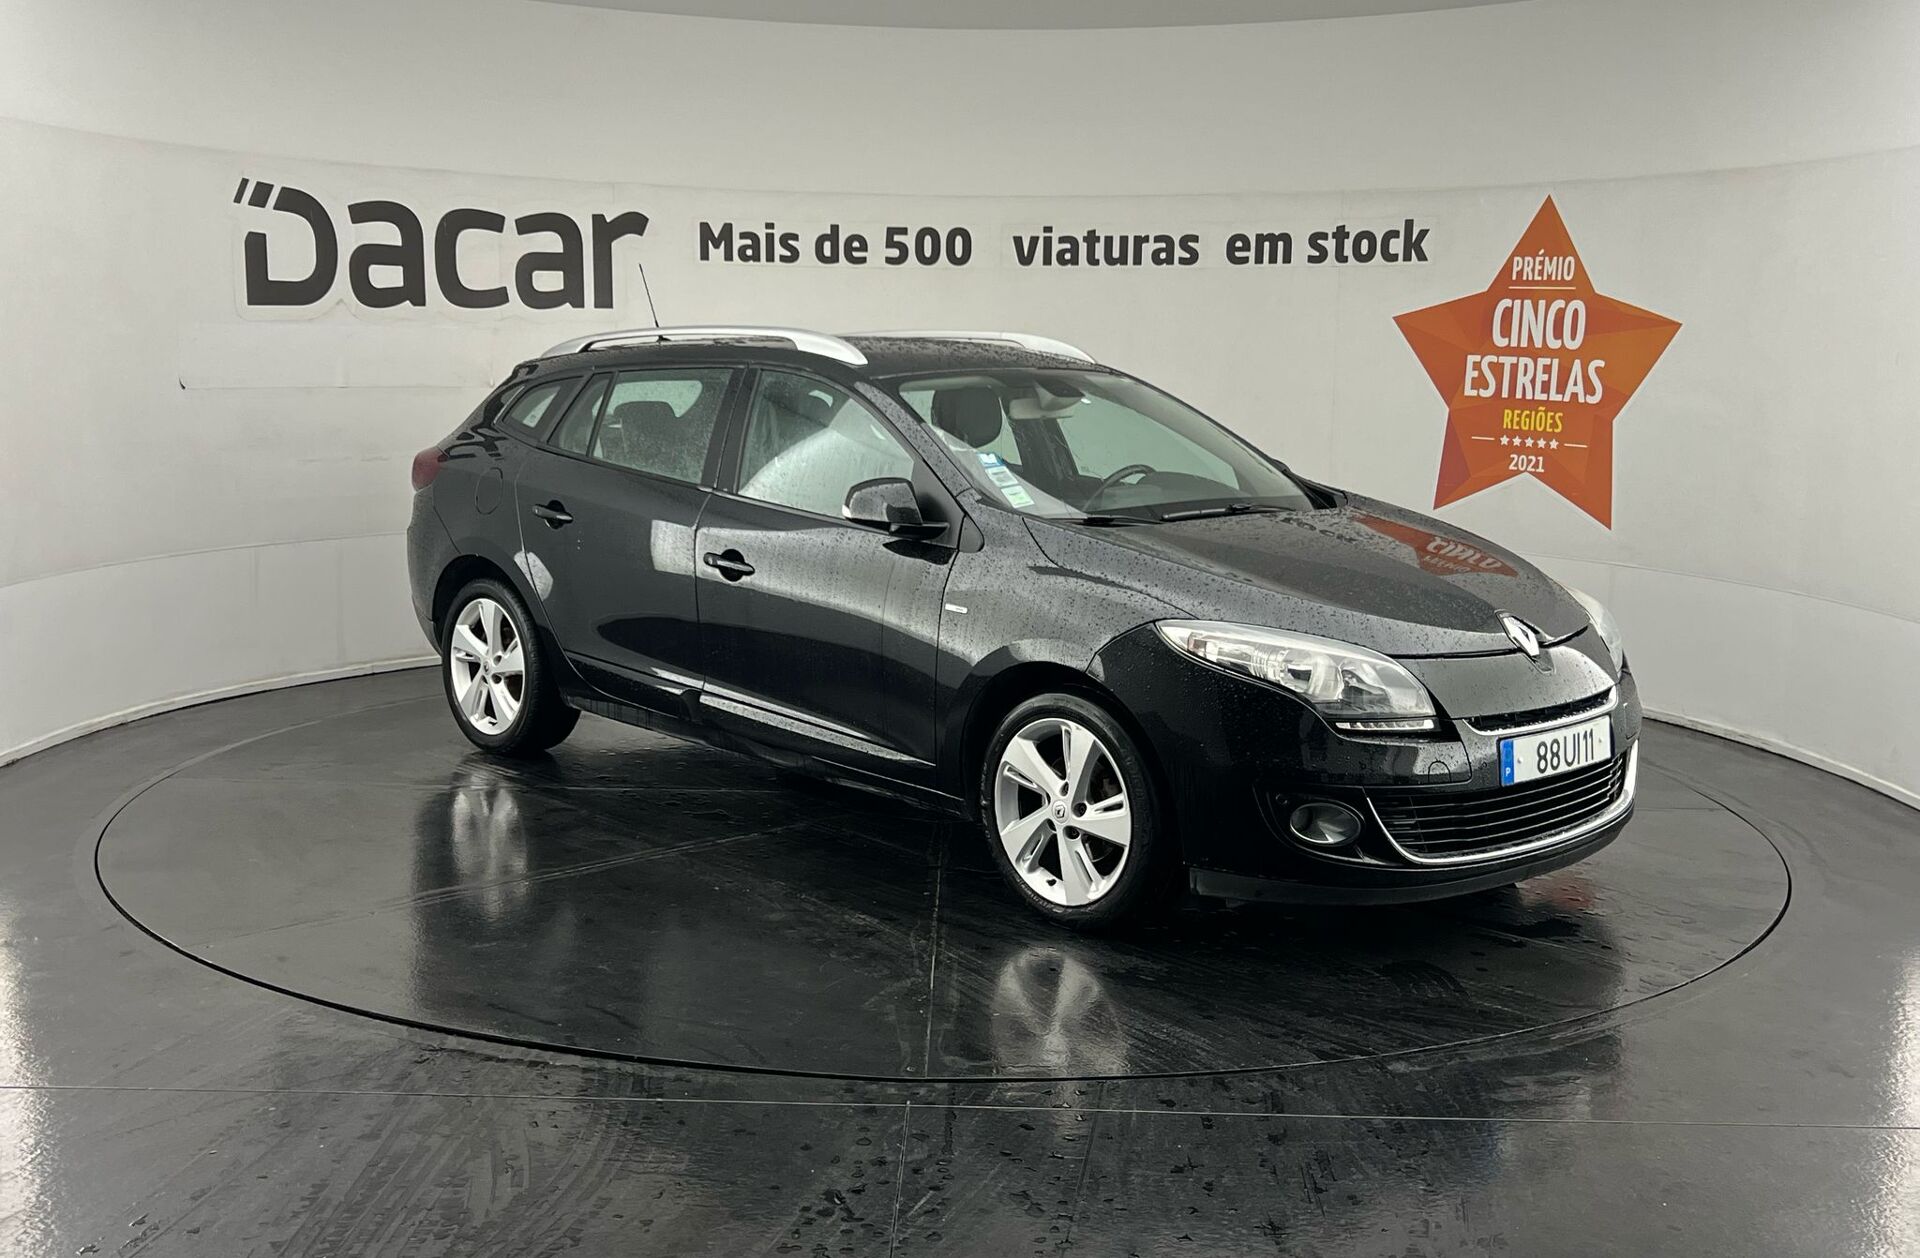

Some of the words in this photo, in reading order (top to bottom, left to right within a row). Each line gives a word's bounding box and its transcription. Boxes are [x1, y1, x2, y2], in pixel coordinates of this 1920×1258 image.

[233, 178, 650, 310] Dacar
[699, 221, 800, 264] Mais
[814, 223, 870, 265] de
[884, 226, 972, 267] 500
[1012, 225, 1200, 267] viaturas
[1225, 232, 1293, 266] em
[1307, 218, 1431, 265] stock
[1511, 248, 1576, 281] PRÉMIO
[1491, 298, 1587, 350] CINCO
[1463, 354, 1606, 405] ESTRELAS
[1503, 406, 1564, 433] REGIÕES
[1508, 453, 1545, 473] 2021
